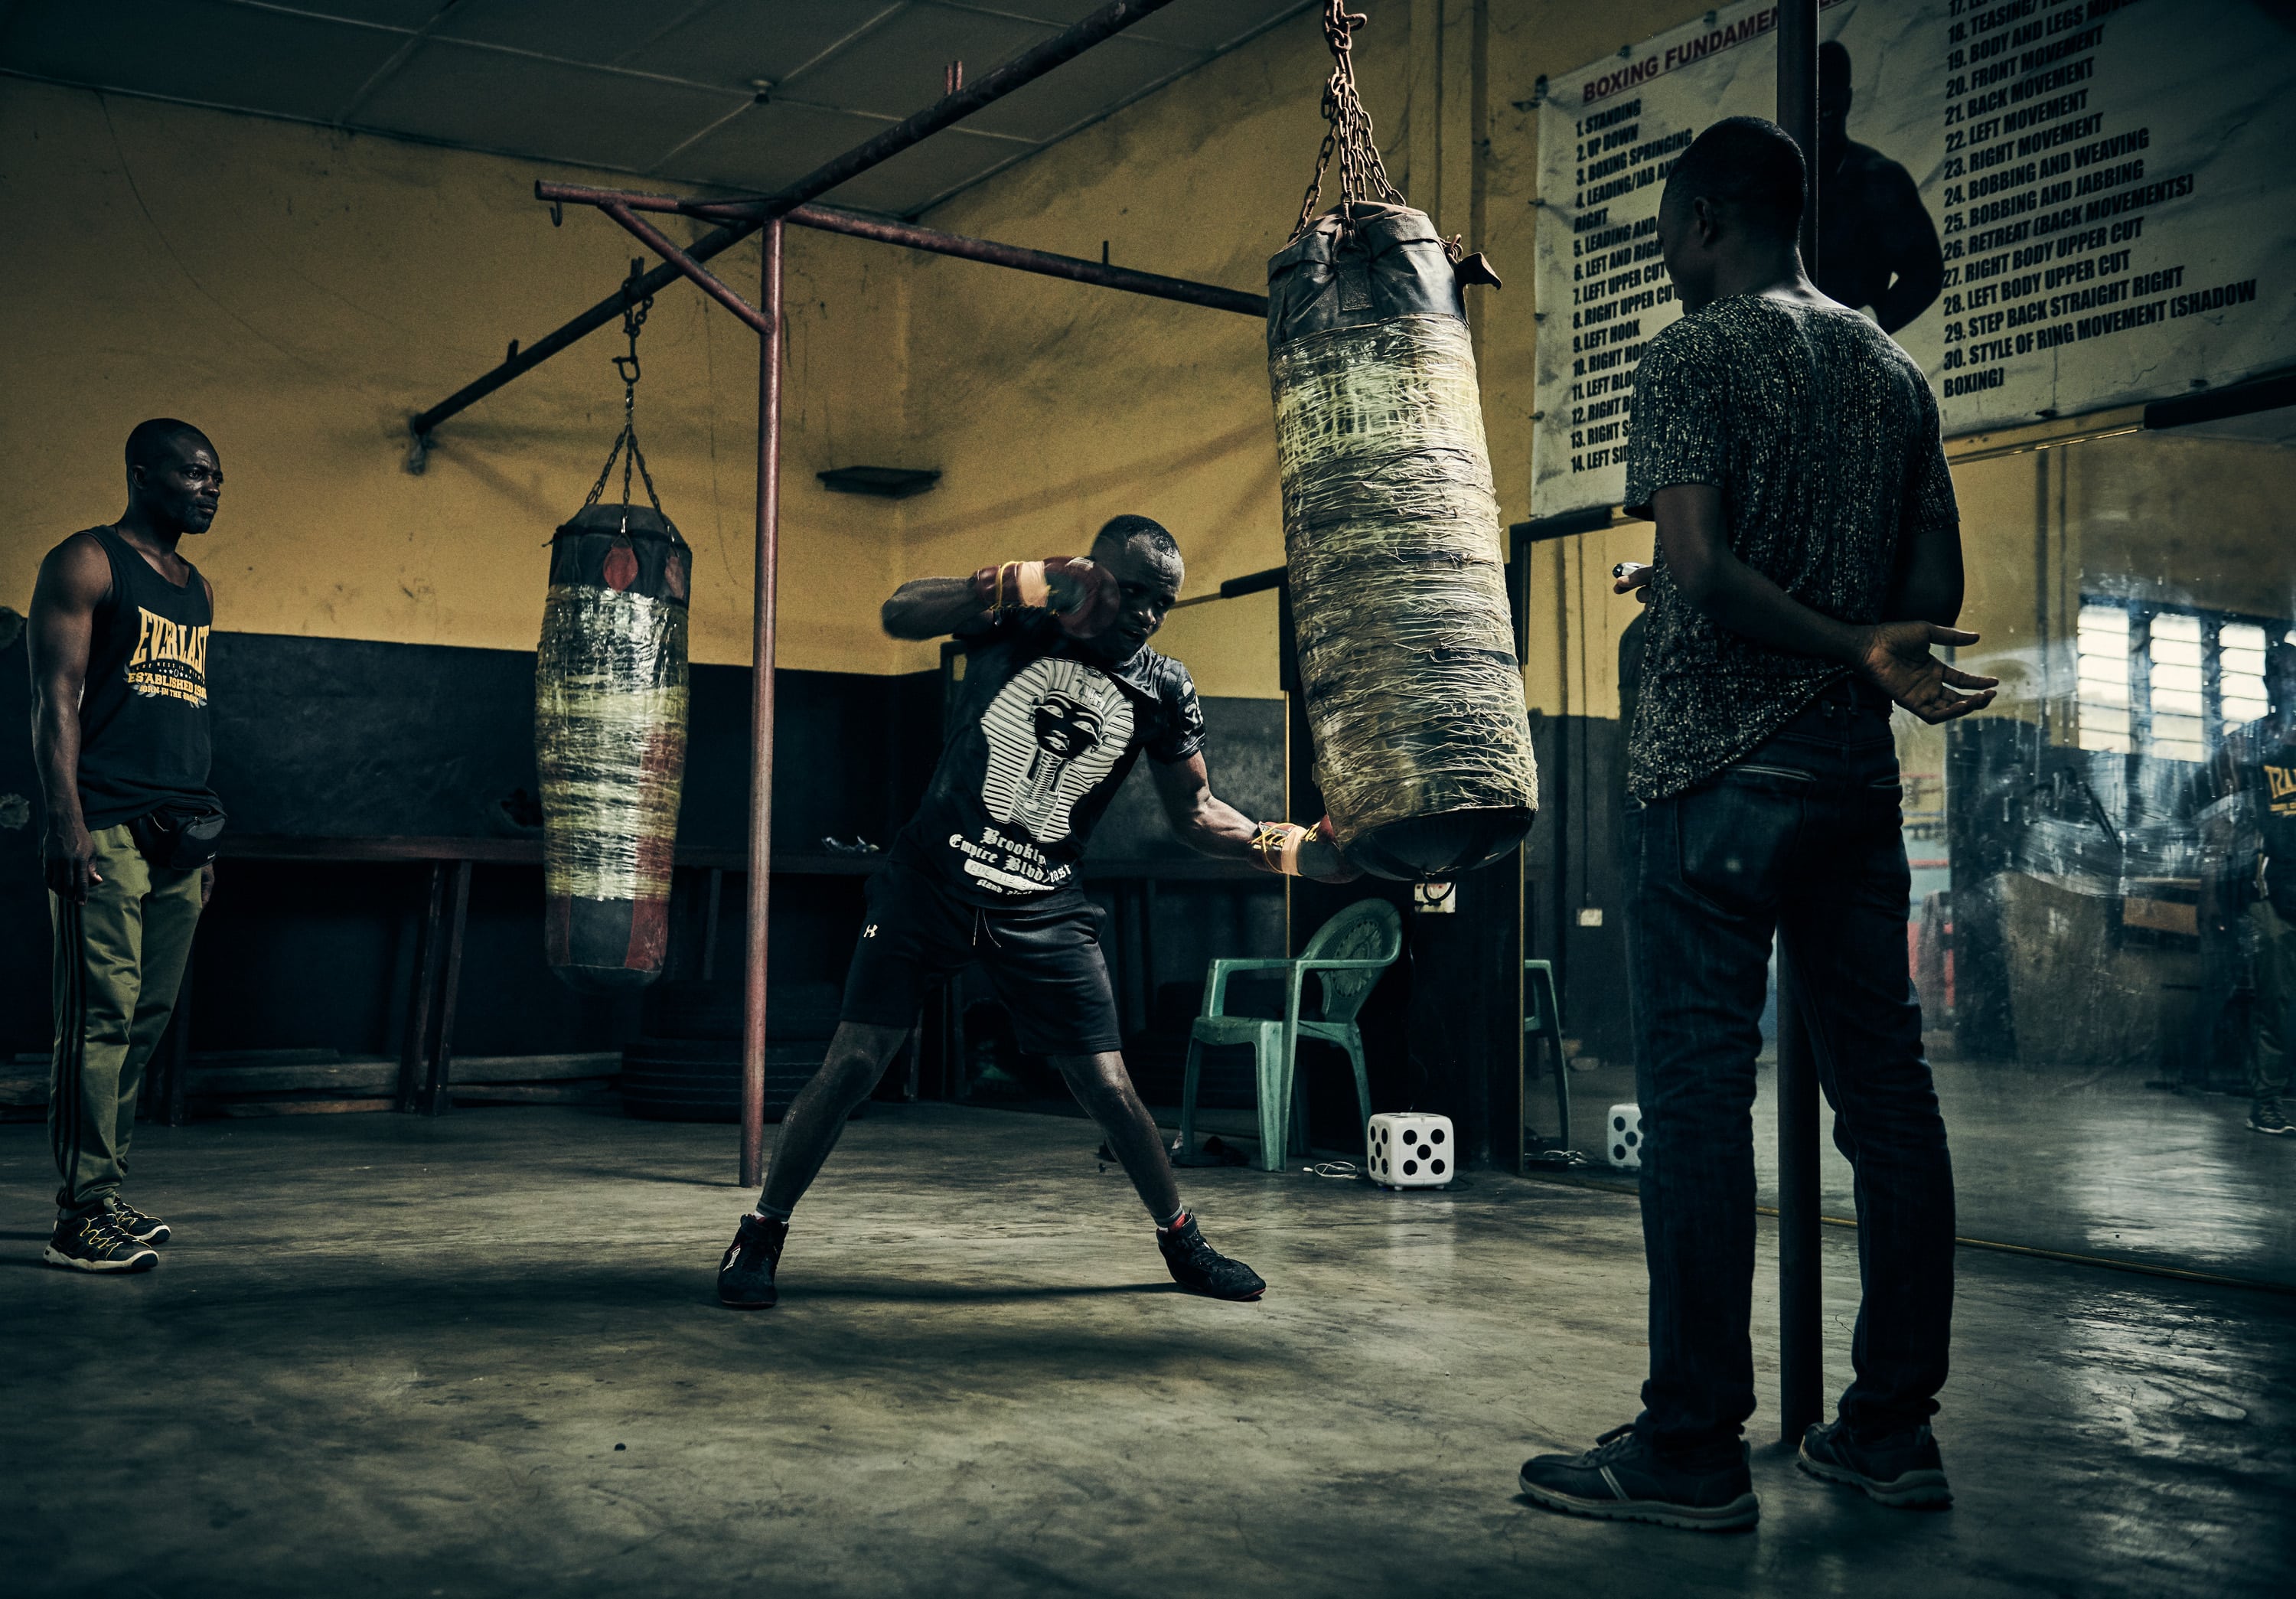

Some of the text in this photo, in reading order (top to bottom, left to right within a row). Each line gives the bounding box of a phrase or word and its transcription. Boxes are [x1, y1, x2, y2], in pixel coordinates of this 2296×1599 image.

[1583, 7, 1778, 103] BOXING FUNDAME
[1946, 50, 1967, 71] 19.
[1970, 31, 2009, 64] BODY
[2011, 20, 2043, 48] AND
[2047, 5, 2083, 37] LEGS
[1948, 22, 1968, 44] 18.
[1945, 24, 2104, 100] 20. FRONT MOVEMENT
[1945, 57, 2094, 126] 21. BACK MOVEMENT
[1577, 98, 1642, 137] 1. STANDING
[1945, 88, 2089, 154] 22. LEFT MOVEMENT
[1577, 123, 1639, 162] 2. UP DOWN
[1577, 129, 1692, 186] 3. BOXING SPRINGING
[1944, 113, 2103, 181] 23. RIGHT MOVEMENT
[1575, 193, 1585, 208] 4.
[1657, 160, 1673, 181] AN
[1945, 127, 2150, 208] 24. BOBBING AND WEAVING
[1944, 158, 2144, 235] 25. BOBBING AND JABBING
[1574, 207, 1608, 233] RIGHT
[1574, 216, 1656, 257] 5. LEADING AND
[1944, 239, 1965, 262] 26.
[1968, 220, 2030, 254] RETREAT
[1574, 240, 1662, 281] 6. LEFT AND RIGH
[1943, 216, 2144, 289] 27. RIGHT BODY UPPER CUT
[1574, 262, 1665, 305] 7. LEFT UPPER CUT
[1944, 249, 2131, 316] 28. LEFT BODY UPPER CUT
[1945, 265, 2185, 344] 29. STEP BACK STRAIGHT RIGHT
[1574, 312, 1583, 329] 8.
[1585, 302, 1618, 325] RIGHT
[1620, 290, 1654, 315] UPPER
[1574, 319, 1640, 353] 9. LEFT HOOK
[1943, 348, 1966, 370] 30.
[1969, 337, 2012, 364] STYLE
[2015, 332, 2033, 354] OF
[2037, 322, 2075, 350] RING
[2077, 300, 2167, 341] MOVEMENT
[1573, 341, 1647, 377] 10. RIGHT HOO
[1572, 369, 1636, 401] 11. LEFT BLO
[1572, 407, 1586, 426] 12.
[1587, 397, 1621, 421] RIGHT
[1570, 431, 1585, 449] 13.
[1587, 422, 1619, 445] RIGHT
[1571, 455, 1585, 473] 14.
[1587, 449, 1609, 469] LEFT
[948, 834, 999, 863] Empire
[1003, 854, 1045, 881] Blvd
